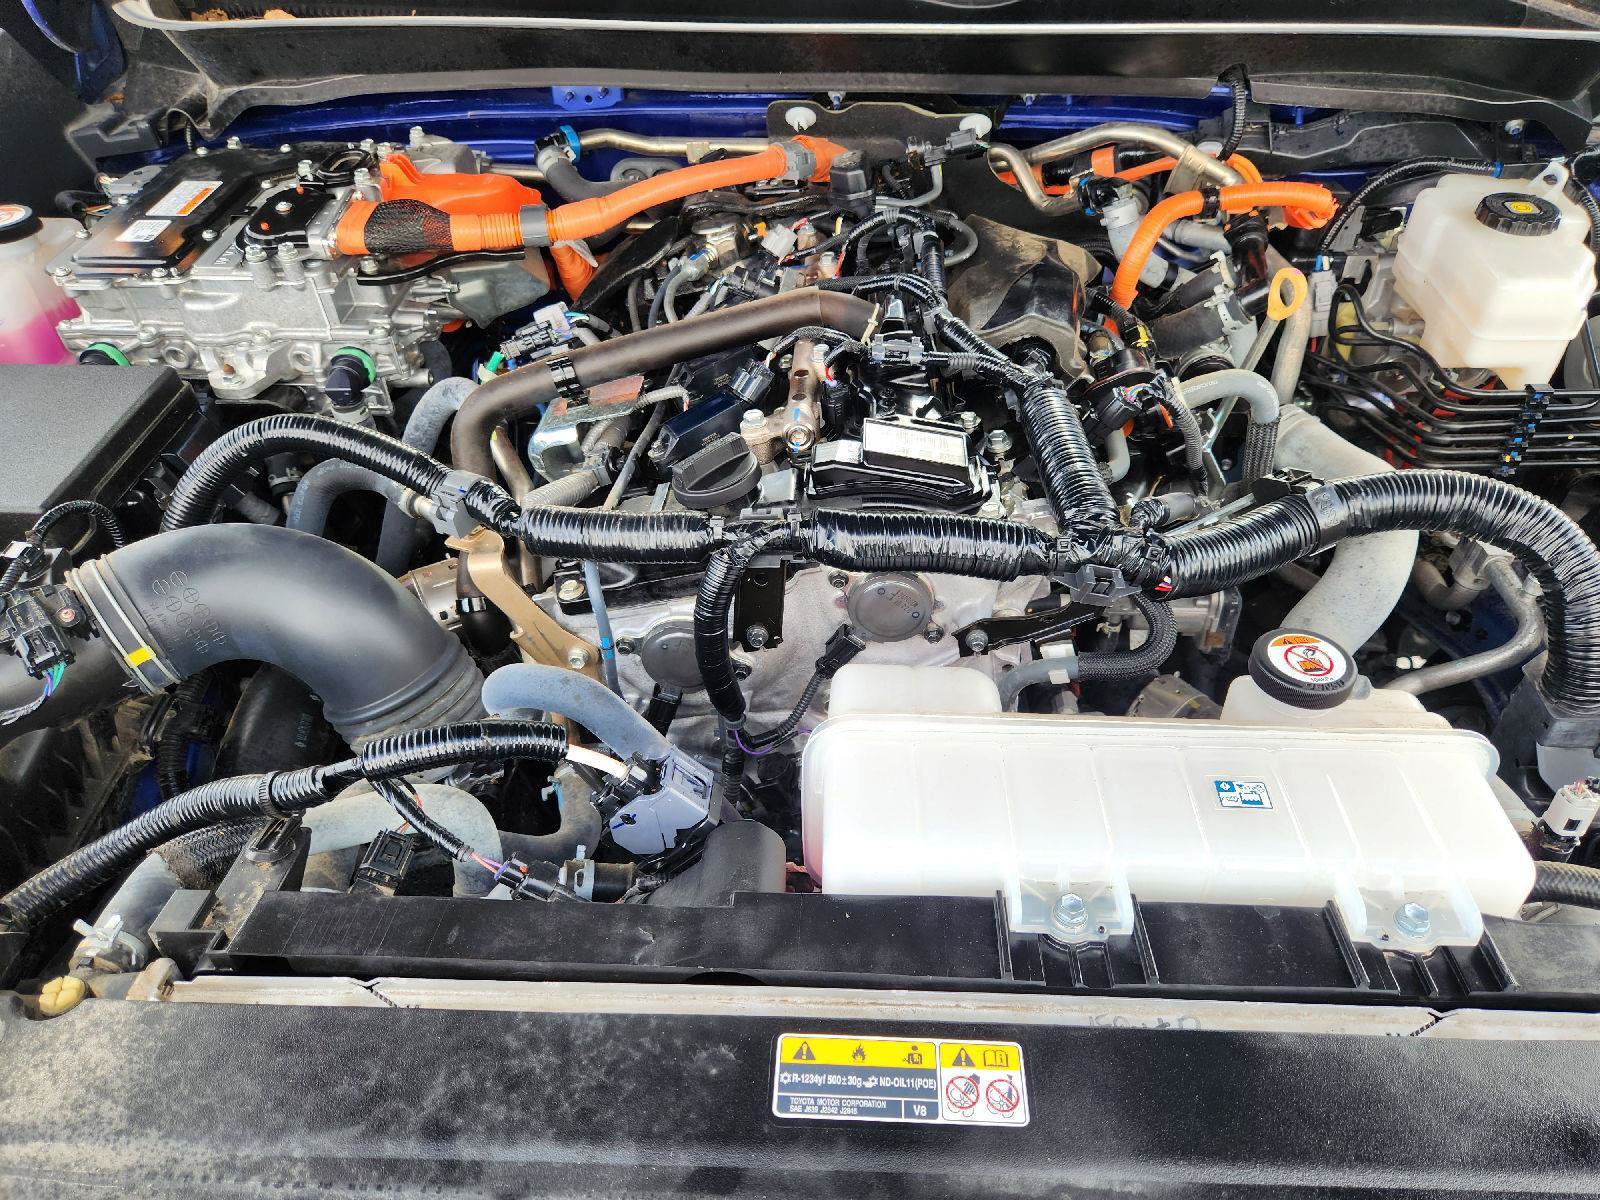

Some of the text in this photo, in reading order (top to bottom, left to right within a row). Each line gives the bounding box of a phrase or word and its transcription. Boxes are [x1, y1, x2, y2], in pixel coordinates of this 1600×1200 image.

[792, 1073, 826, 1087] R-1234yf
[879, 1076, 937, 1091] ND-OIL11(POE)
[789, 1097, 887, 1108] TOYOTA MOTOR CORPORATION
[789, 1105, 803, 1113] SAE
[912, 1104, 927, 1117] V8
